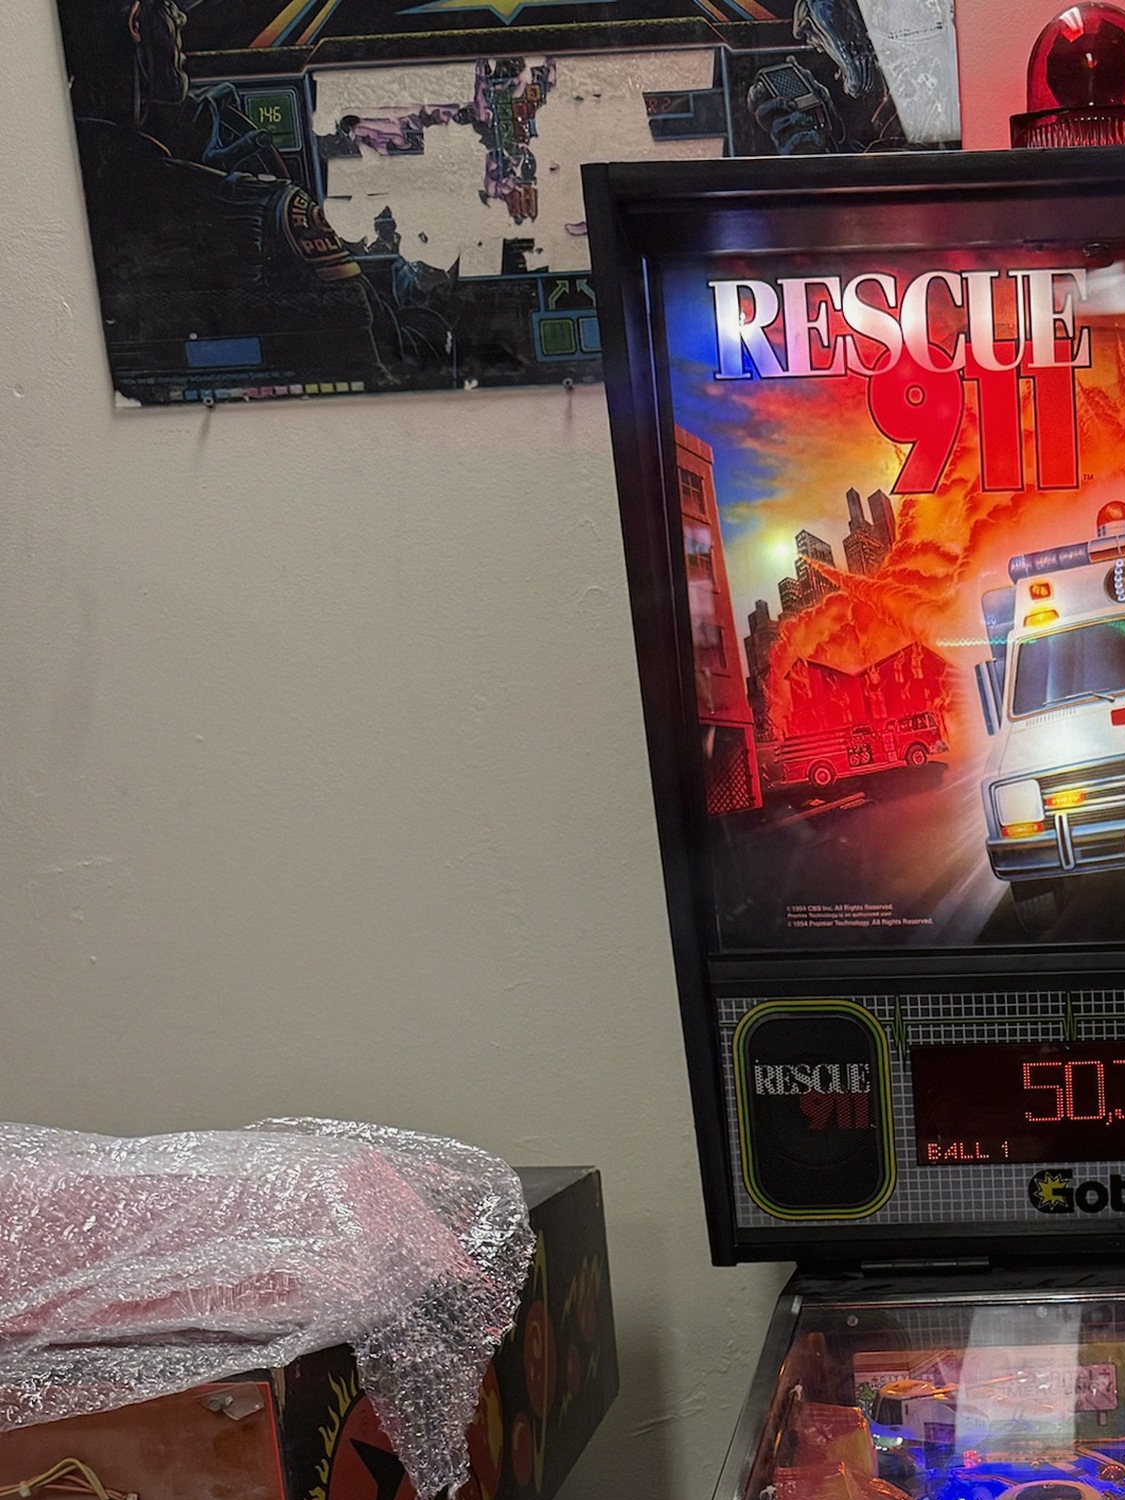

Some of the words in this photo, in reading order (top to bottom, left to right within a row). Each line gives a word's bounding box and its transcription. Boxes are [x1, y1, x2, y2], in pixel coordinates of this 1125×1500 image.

[257, 107, 282, 124] 146
[708, 267, 1091, 380] RESCUE
[867, 338, 1080, 495] 911
[755, 1063, 871, 1096] RESCUE
[927, 1141, 990, 1161] BALL
[1000, 1140, 1009, 1158] 1
